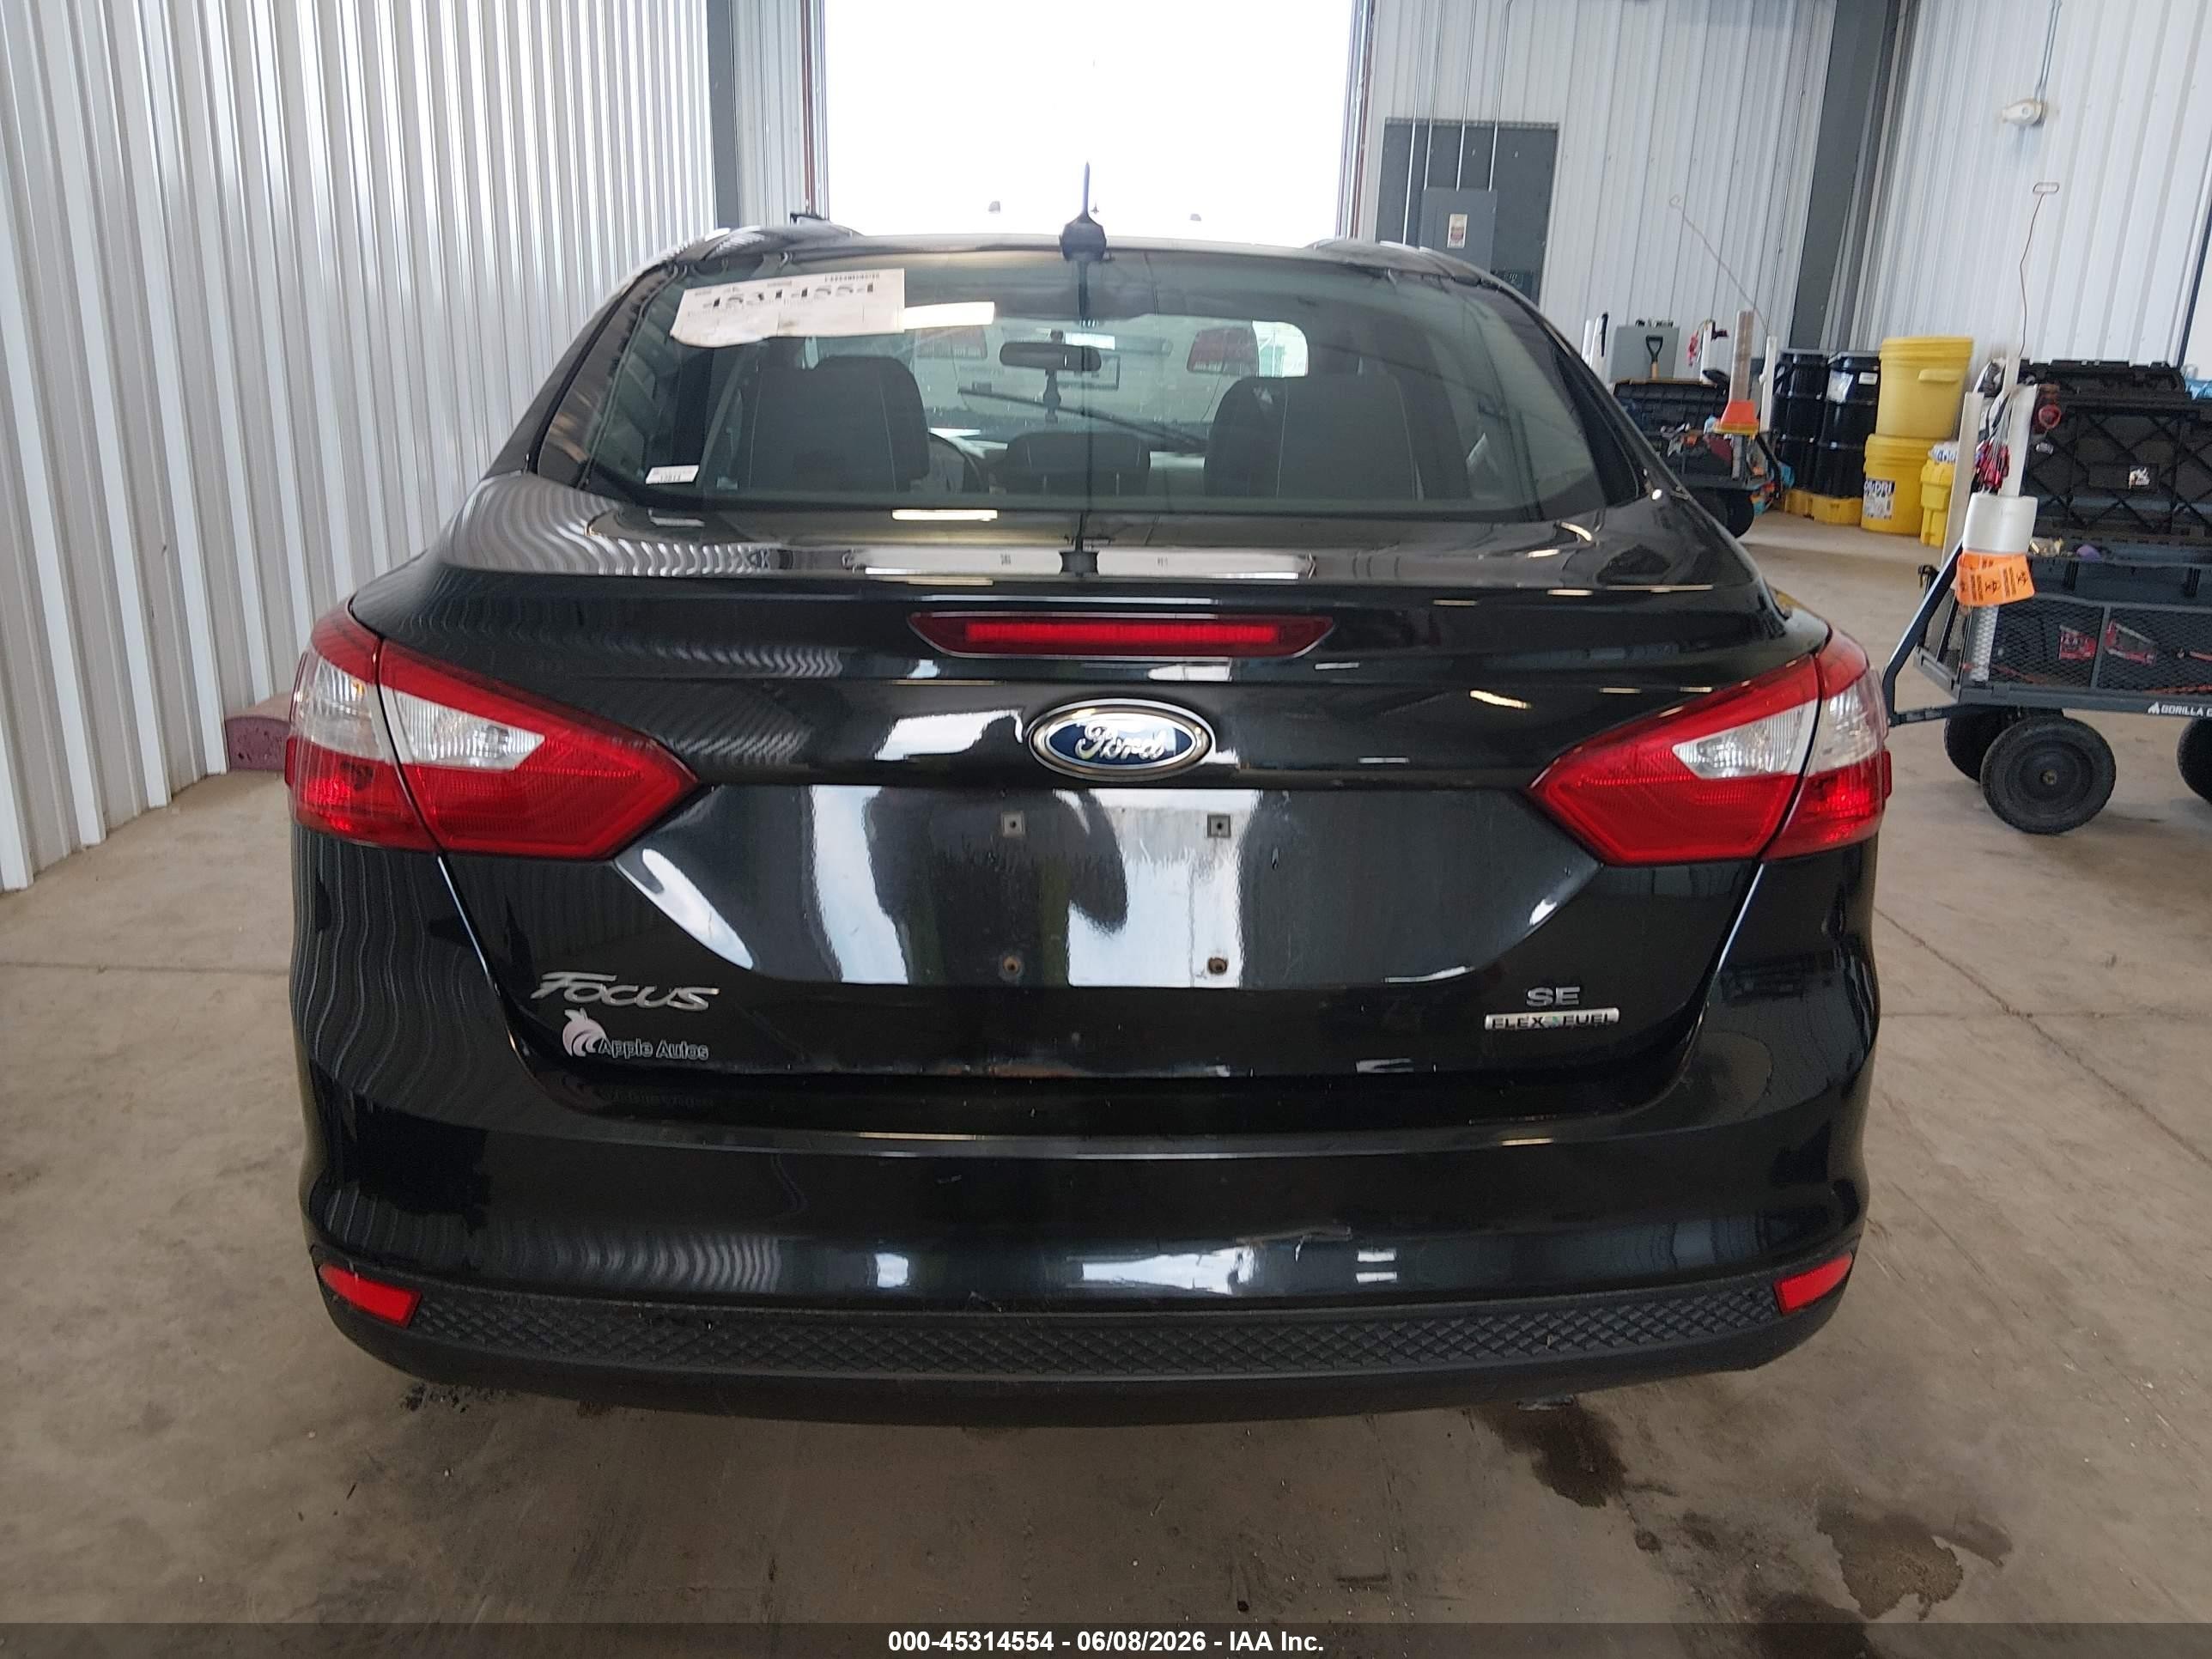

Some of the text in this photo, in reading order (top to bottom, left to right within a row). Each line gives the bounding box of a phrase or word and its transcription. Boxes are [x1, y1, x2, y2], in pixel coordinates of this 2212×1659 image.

[2161, 704, 2203, 717] GORILLA
[1075, 720, 1166, 760] Ford
[1526, 987, 1581, 1006] SE
[1492, 1012, 1615, 1030] FLEX FUEL
[599, 1037, 709, 1061] Apple Autos
